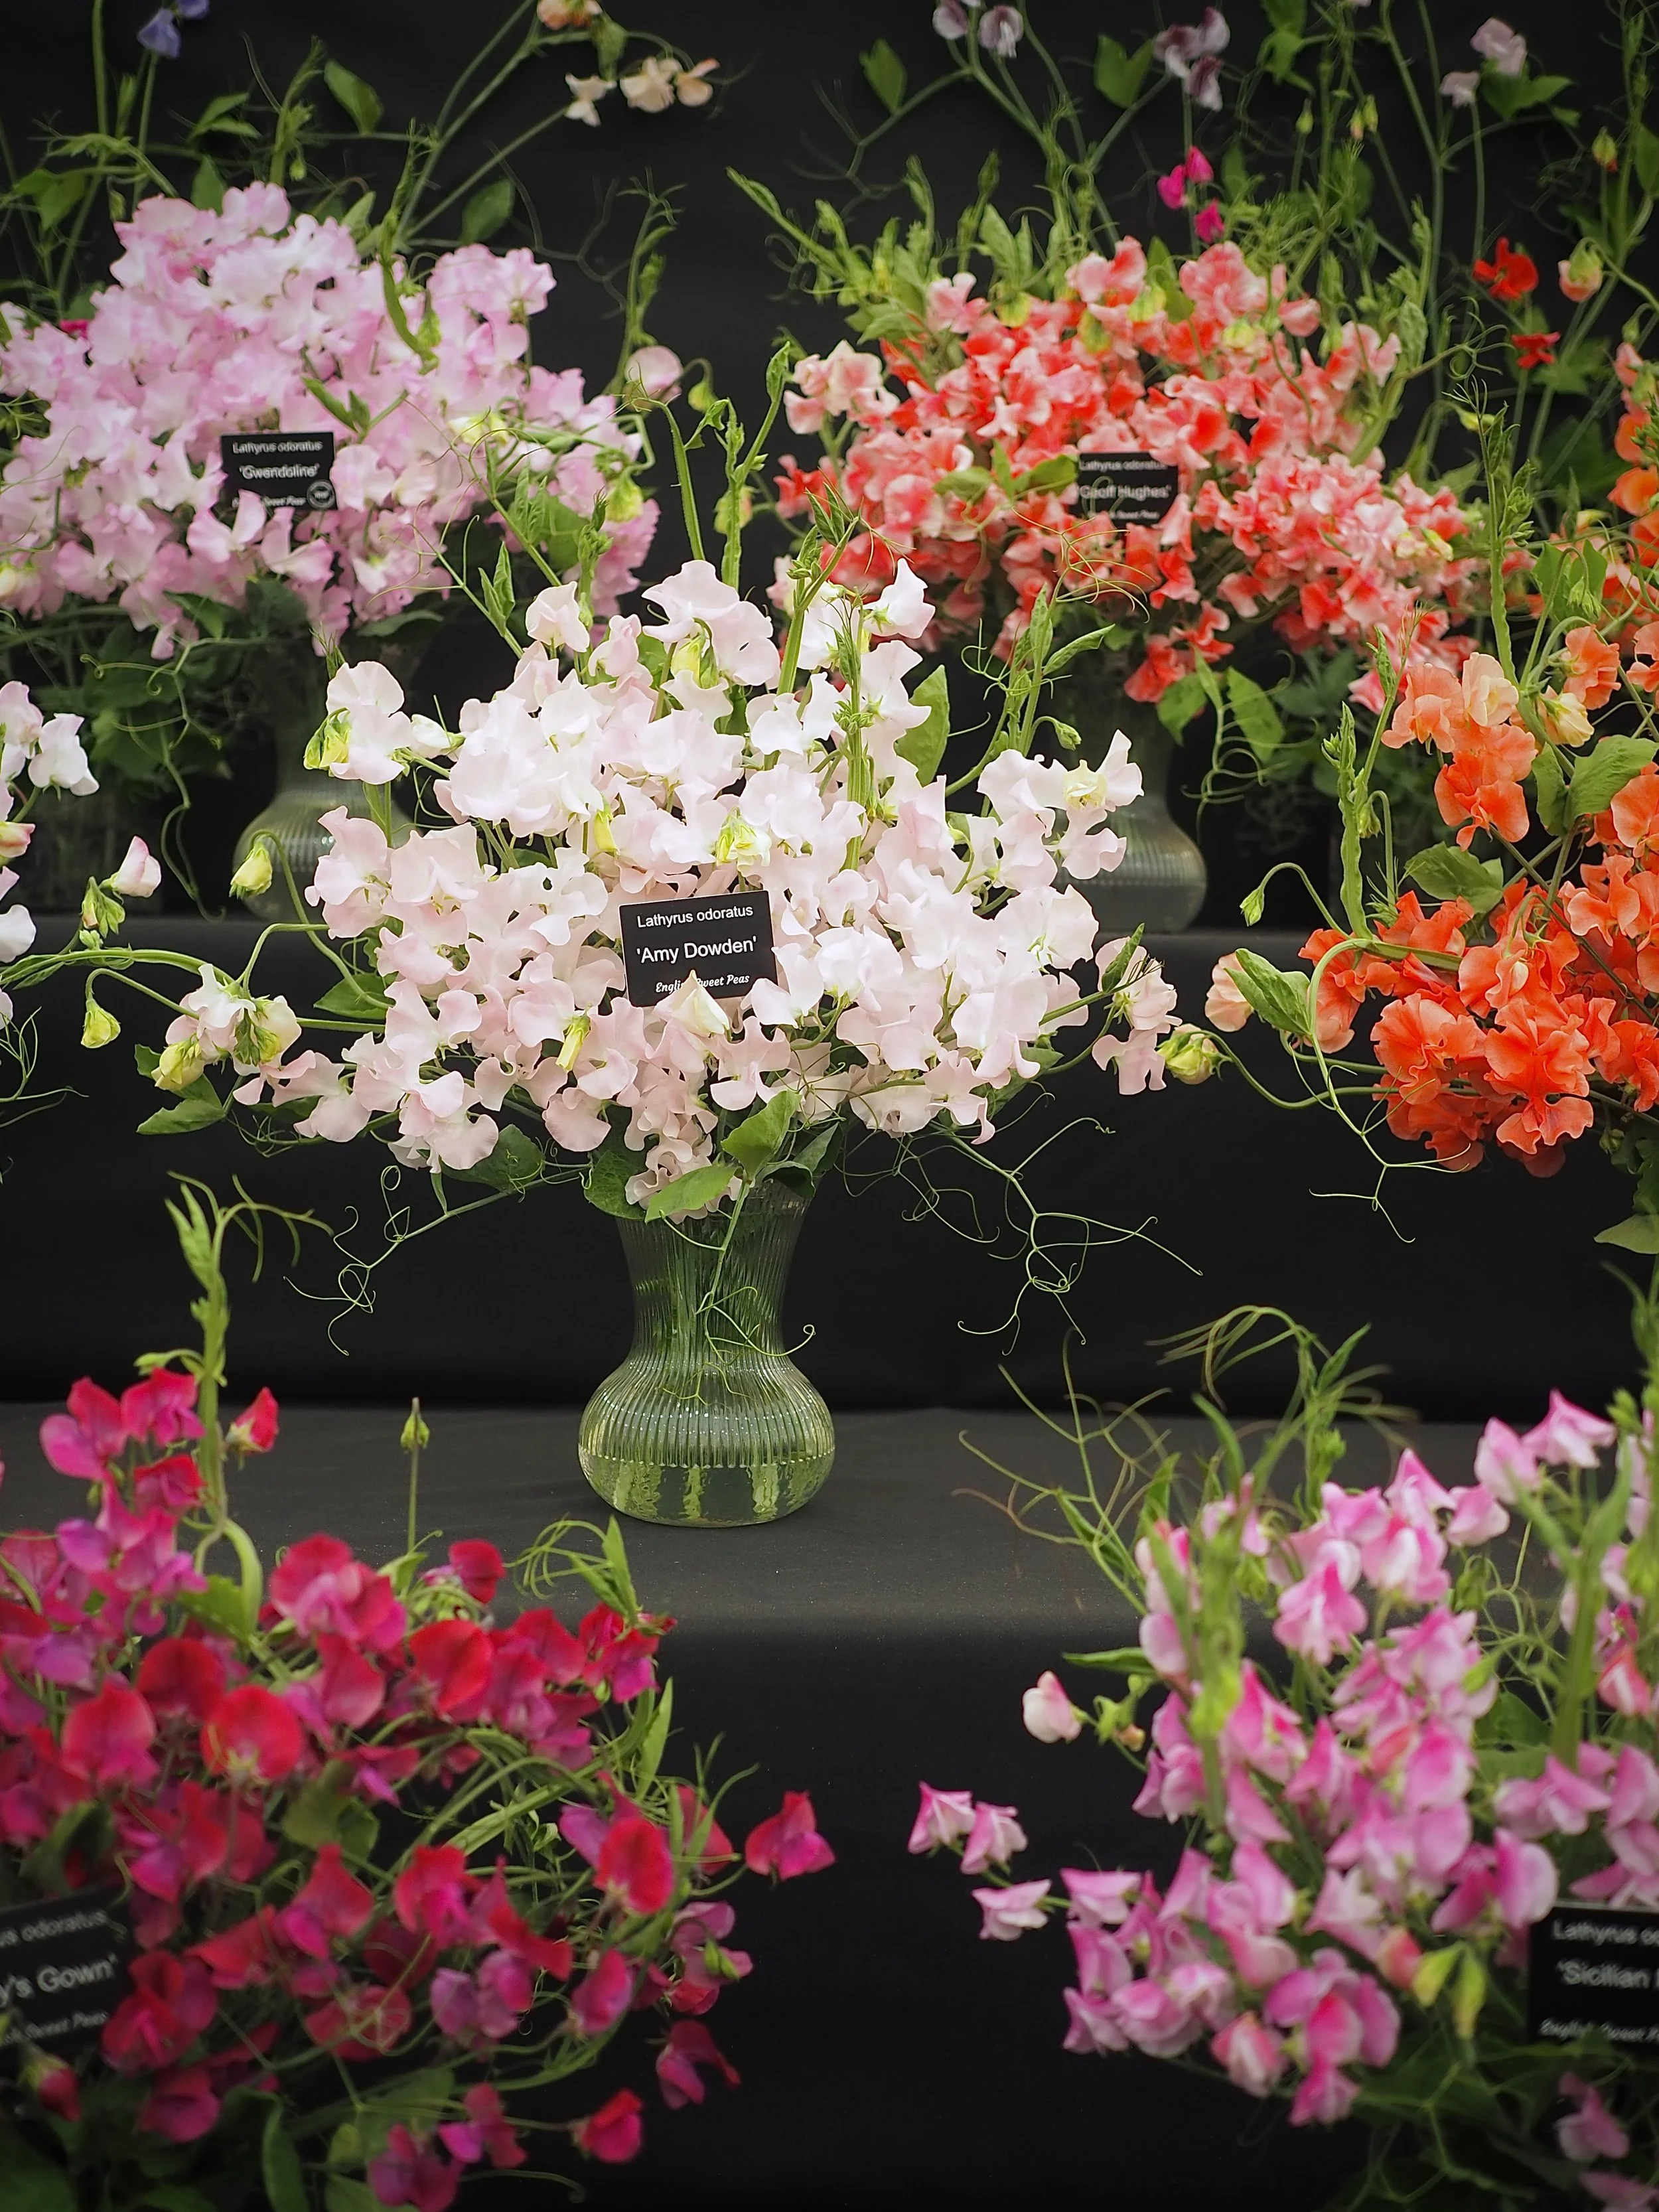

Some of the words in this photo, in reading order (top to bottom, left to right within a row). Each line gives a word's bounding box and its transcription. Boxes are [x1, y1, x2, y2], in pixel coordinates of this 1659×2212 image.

[232, 441, 277, 455] Lathyrus
[277, 440, 323, 453] odoratus
[637, 913, 693, 928] Lathyrus
[697, 905, 754, 922] odoratus
[636, 945, 680, 964] 'Amy
[684, 935, 757, 959] Dowden'
[655, 980, 685, 995] Engli
[726, 974, 750, 985] Peas
